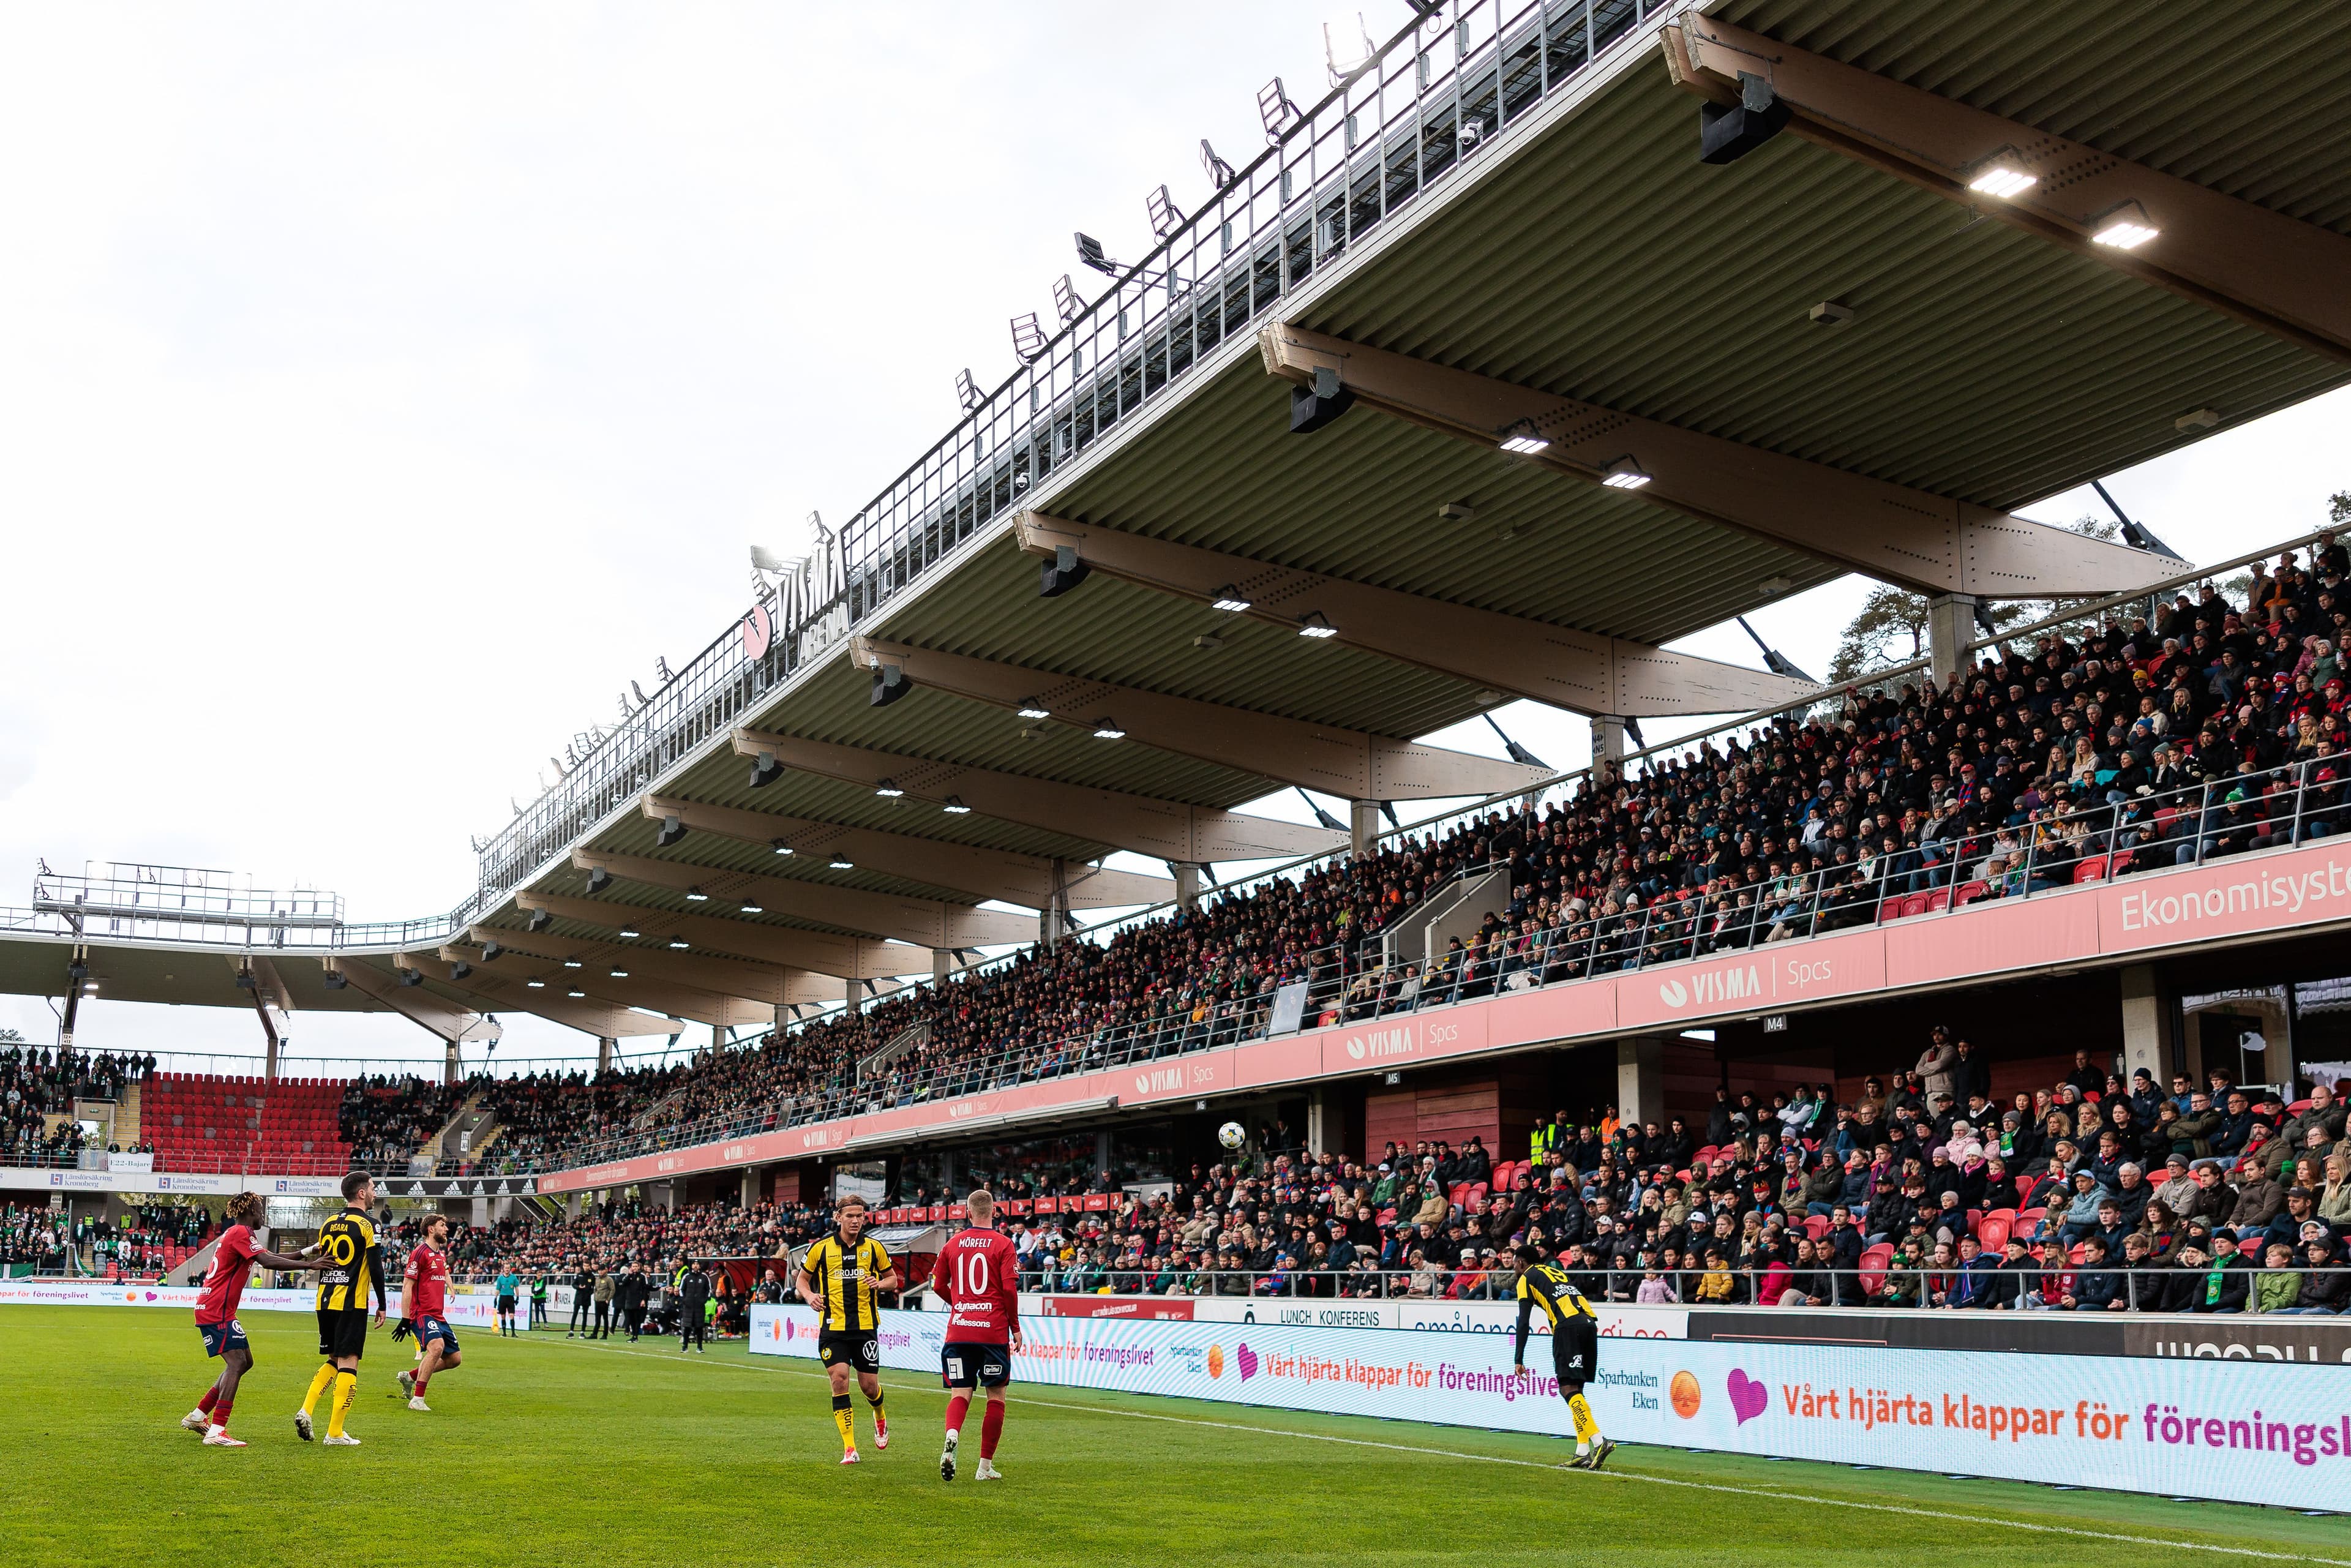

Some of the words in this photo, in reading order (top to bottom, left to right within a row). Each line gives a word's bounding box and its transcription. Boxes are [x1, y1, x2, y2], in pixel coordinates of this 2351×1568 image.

[776, 530, 846, 641] VISMA
[798, 602, 850, 668] ARENA
[2121, 860, 2351, 931] Ekonomisyst
[1692, 965, 1761, 1004] VISMA
[1788, 960, 1831, 989] Spcs
[1768, 1017, 1783, 1030] M4
[1368, 1027, 1413, 1057] VISMA
[1430, 1024, 1458, 1046] Spcs
[1151, 1068, 1182, 1093] VISMA
[1193, 1066, 1213, 1086] Spcs
[1388, 1073, 1398, 1084] M5
[957, 1103, 972, 1116] VISMA
[811, 1135, 827, 1147] VISMA
[321, 1234, 355, 1266] 20
[958, 1237, 992, 1248] MÖRFELT
[833, 1269, 865, 1278] PROJOB
[958, 1252, 988, 1295] 10
[1537, 1266, 1568, 1283] 19
[18, 1289, 29, 1297] för
[33, 1288, 89, 1300] föreningslivet
[183, 1292, 198, 1304] hjärt
[954, 1301, 992, 1312] dynacon
[951, 1313, 991, 1327] Fellessons
[1281, 1310, 1311, 1324] LUNCH
[1319, 1310, 1380, 1327] KONFERENS
[878, 1328, 910, 1349] ningslivet
[1029, 1338, 1065, 1364] klappar
[1065, 1340, 1081, 1360] för
[1083, 1341, 1154, 1369] föreningslivet
[1169, 1343, 1202, 1359] Sparbanken
[1187, 1359, 1202, 1373] Eken
[1266, 1352, 1294, 1378] Vårt
[1299, 1355, 1341, 1386] hjärta
[1346, 1358, 1403, 1392] klappar
[1407, 1360, 1432, 1388] för
[1438, 1362, 1559, 1403] föreningslive
[1597, 1368, 1658, 1389] Sparbanken
[1632, 1392, 1658, 1410] Eken
[1570, 1400, 1588, 1426] Clinton.
[1782, 1382, 1840, 1420] Vårt
[1849, 1387, 1933, 1431] hjärta
[1943, 1393, 2065, 1442] klappar
[2074, 1400, 2130, 1441] för
